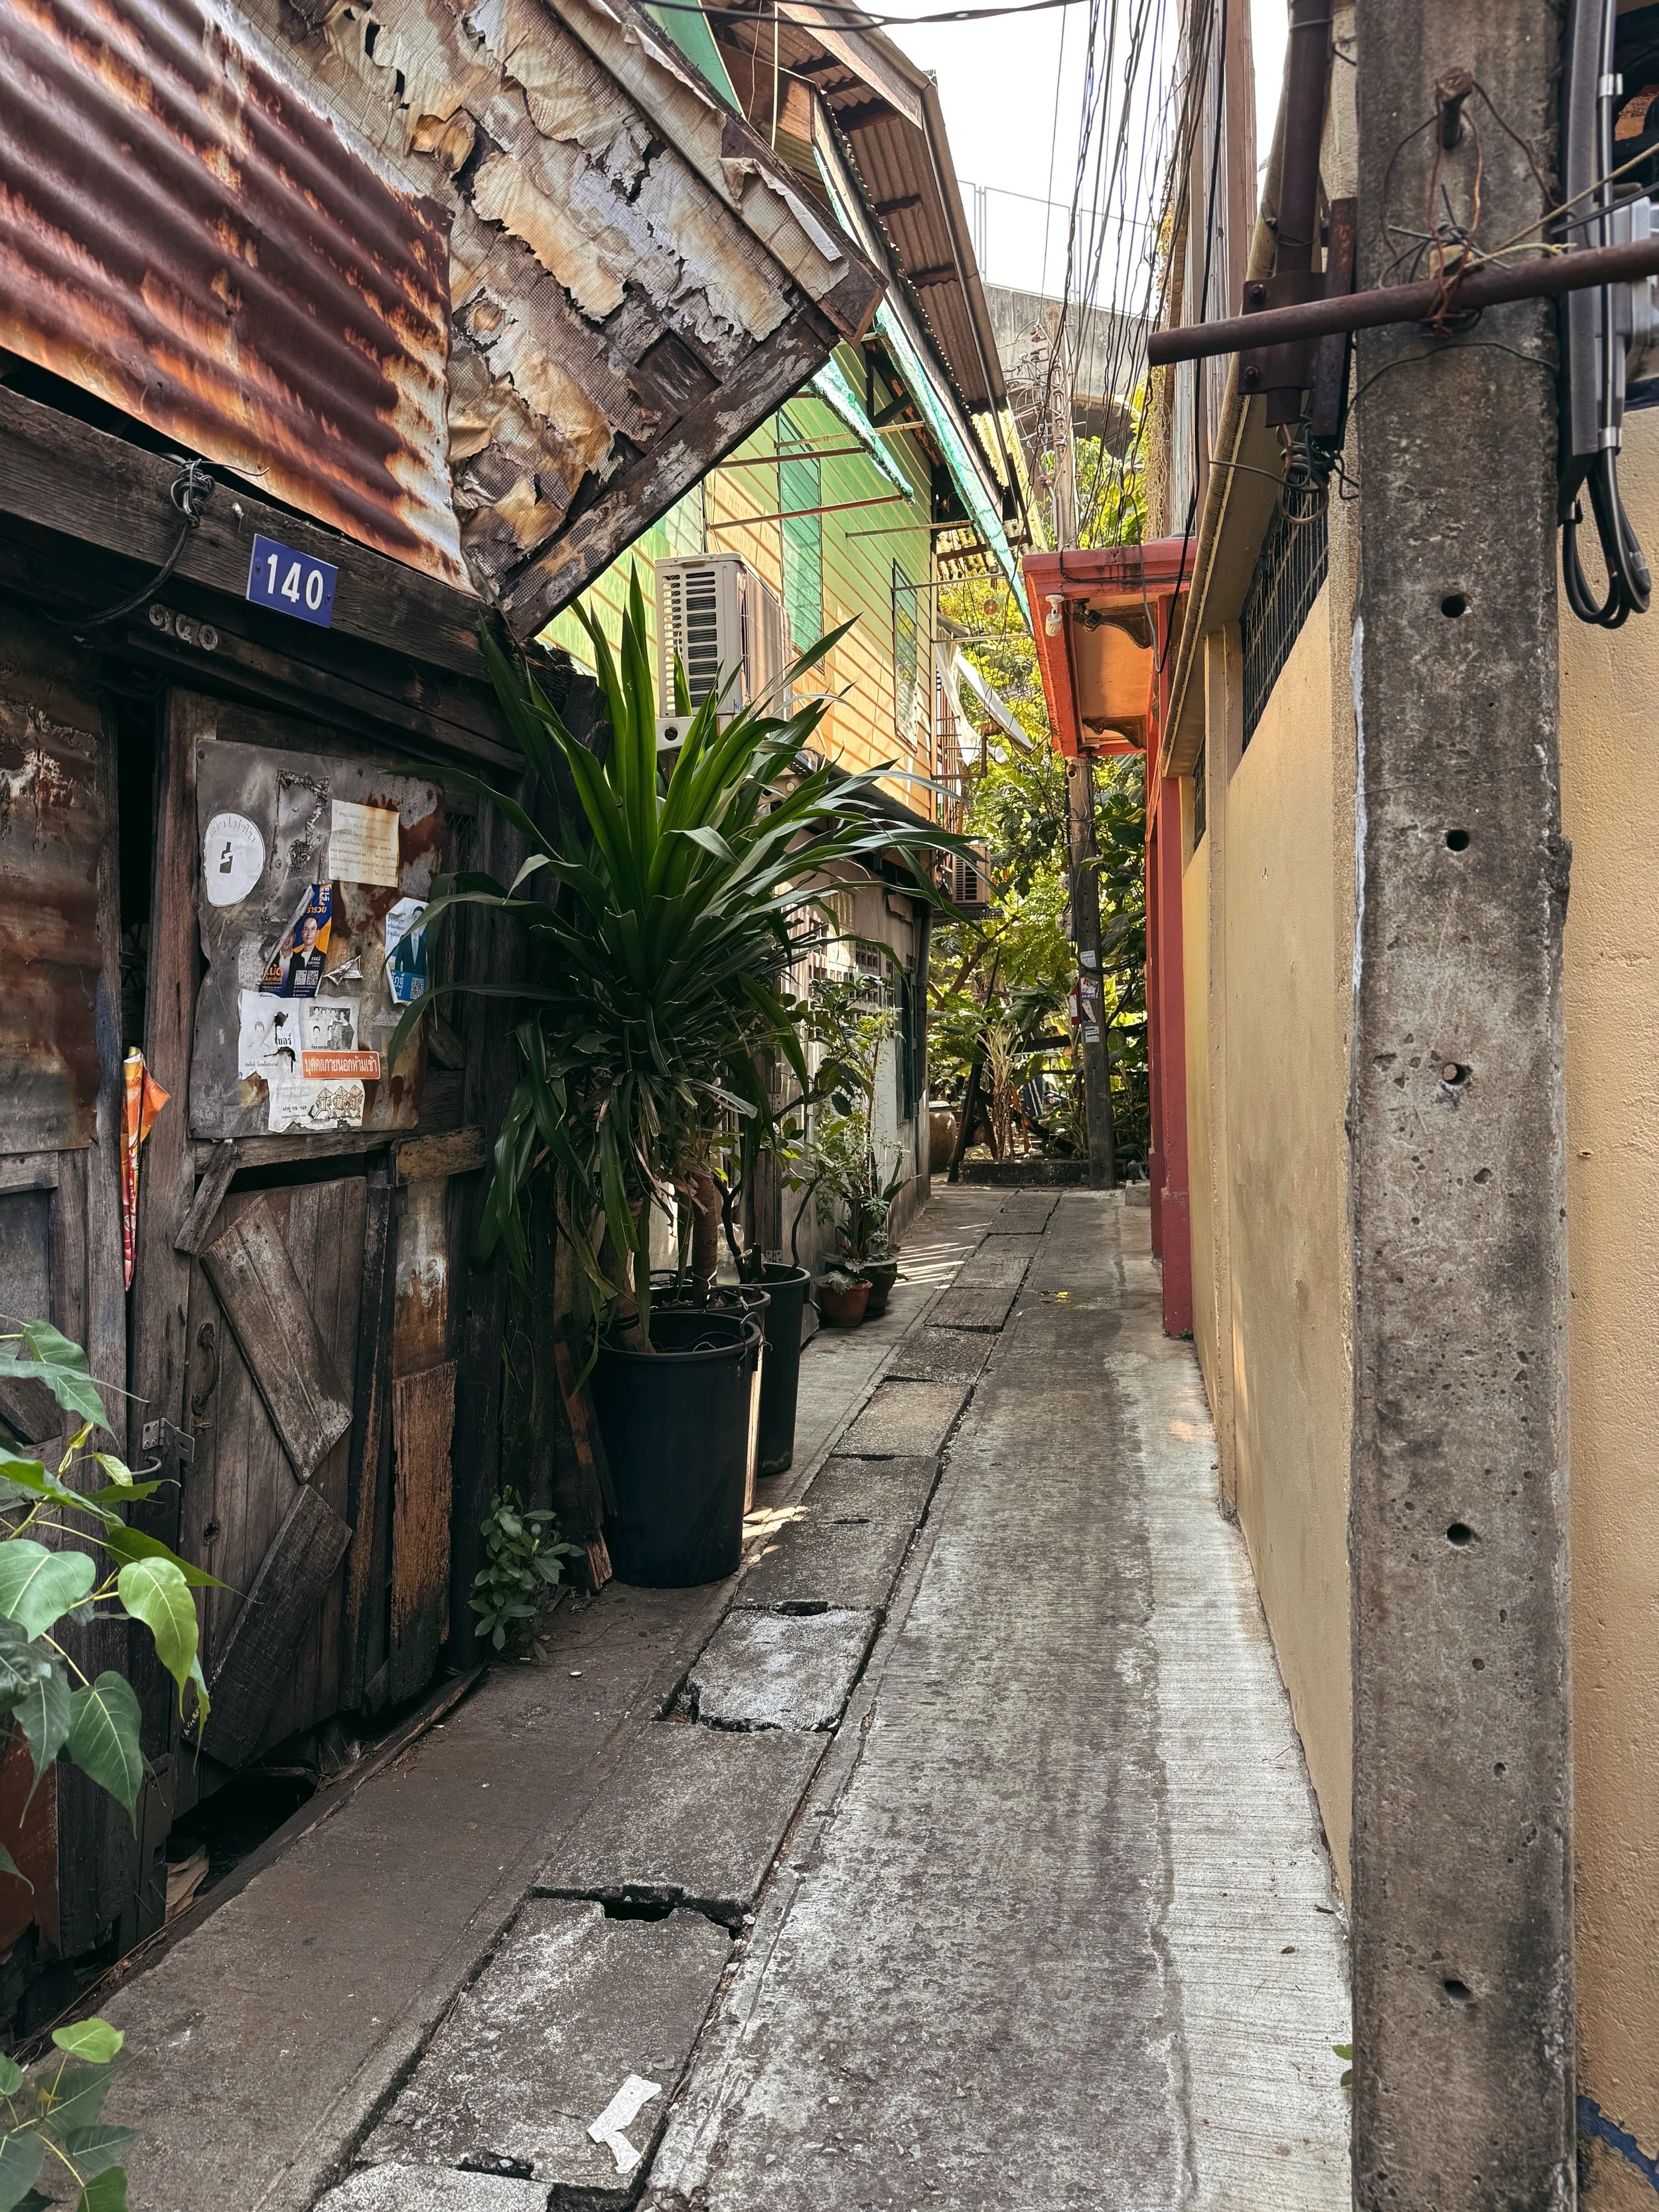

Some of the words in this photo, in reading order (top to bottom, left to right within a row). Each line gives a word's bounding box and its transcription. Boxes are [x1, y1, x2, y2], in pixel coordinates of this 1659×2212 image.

[267, 553, 324, 610] 140
[149, 603, 218, 651] ๑๔๐
[305, 1055, 378, 1076] บุคคลภายนอกห้ามเข้า
